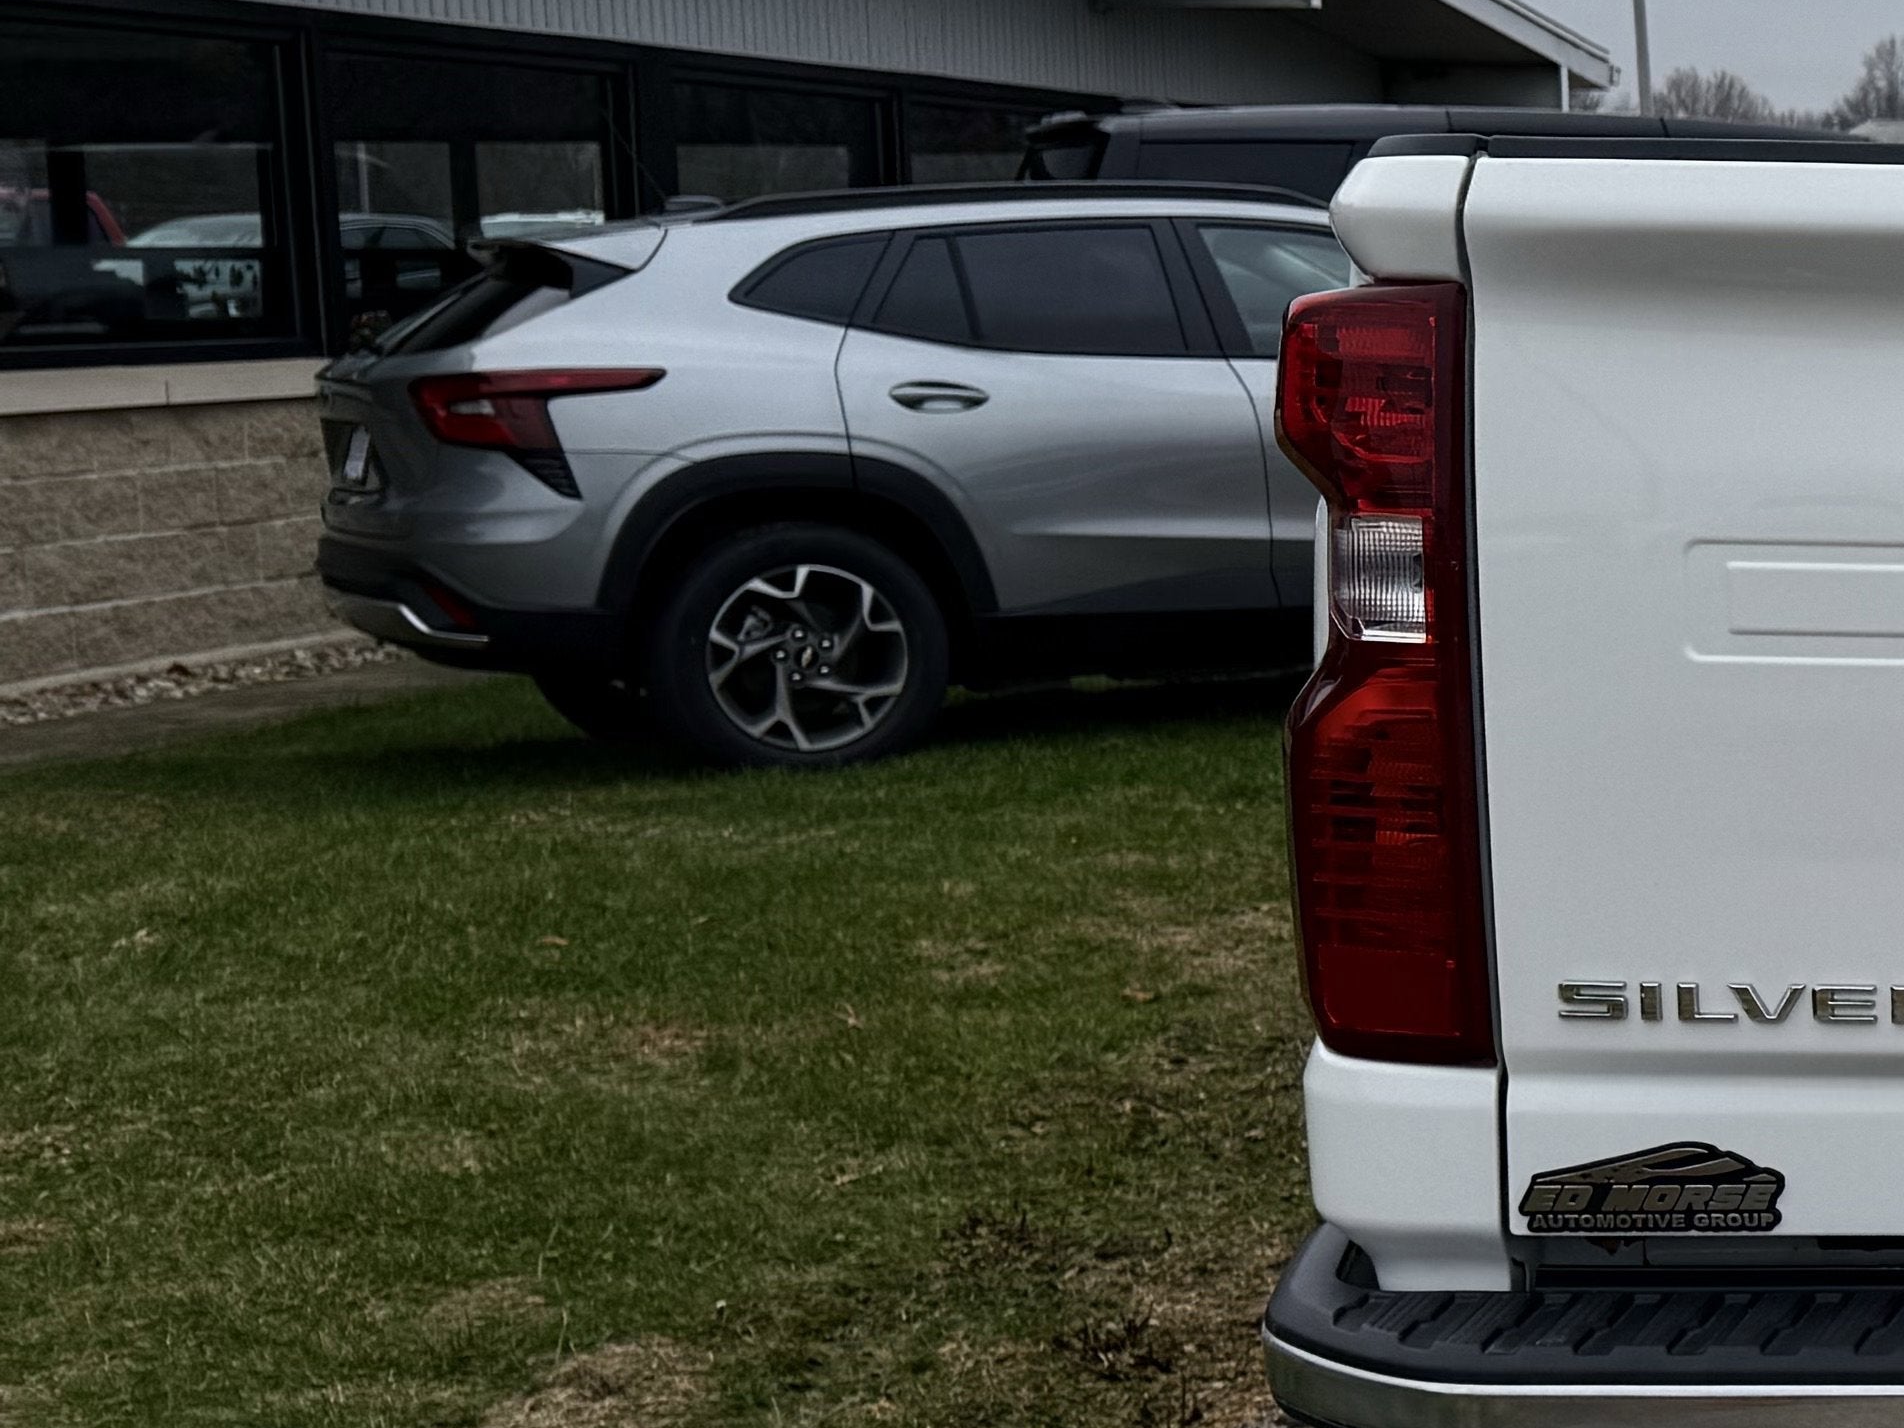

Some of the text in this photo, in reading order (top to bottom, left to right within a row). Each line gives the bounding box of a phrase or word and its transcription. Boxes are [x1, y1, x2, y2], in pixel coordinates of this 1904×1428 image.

[1524, 1184, 1777, 1211] ED MORSE
[1532, 1213, 1775, 1229] AUTOMOTIVE GROUP
